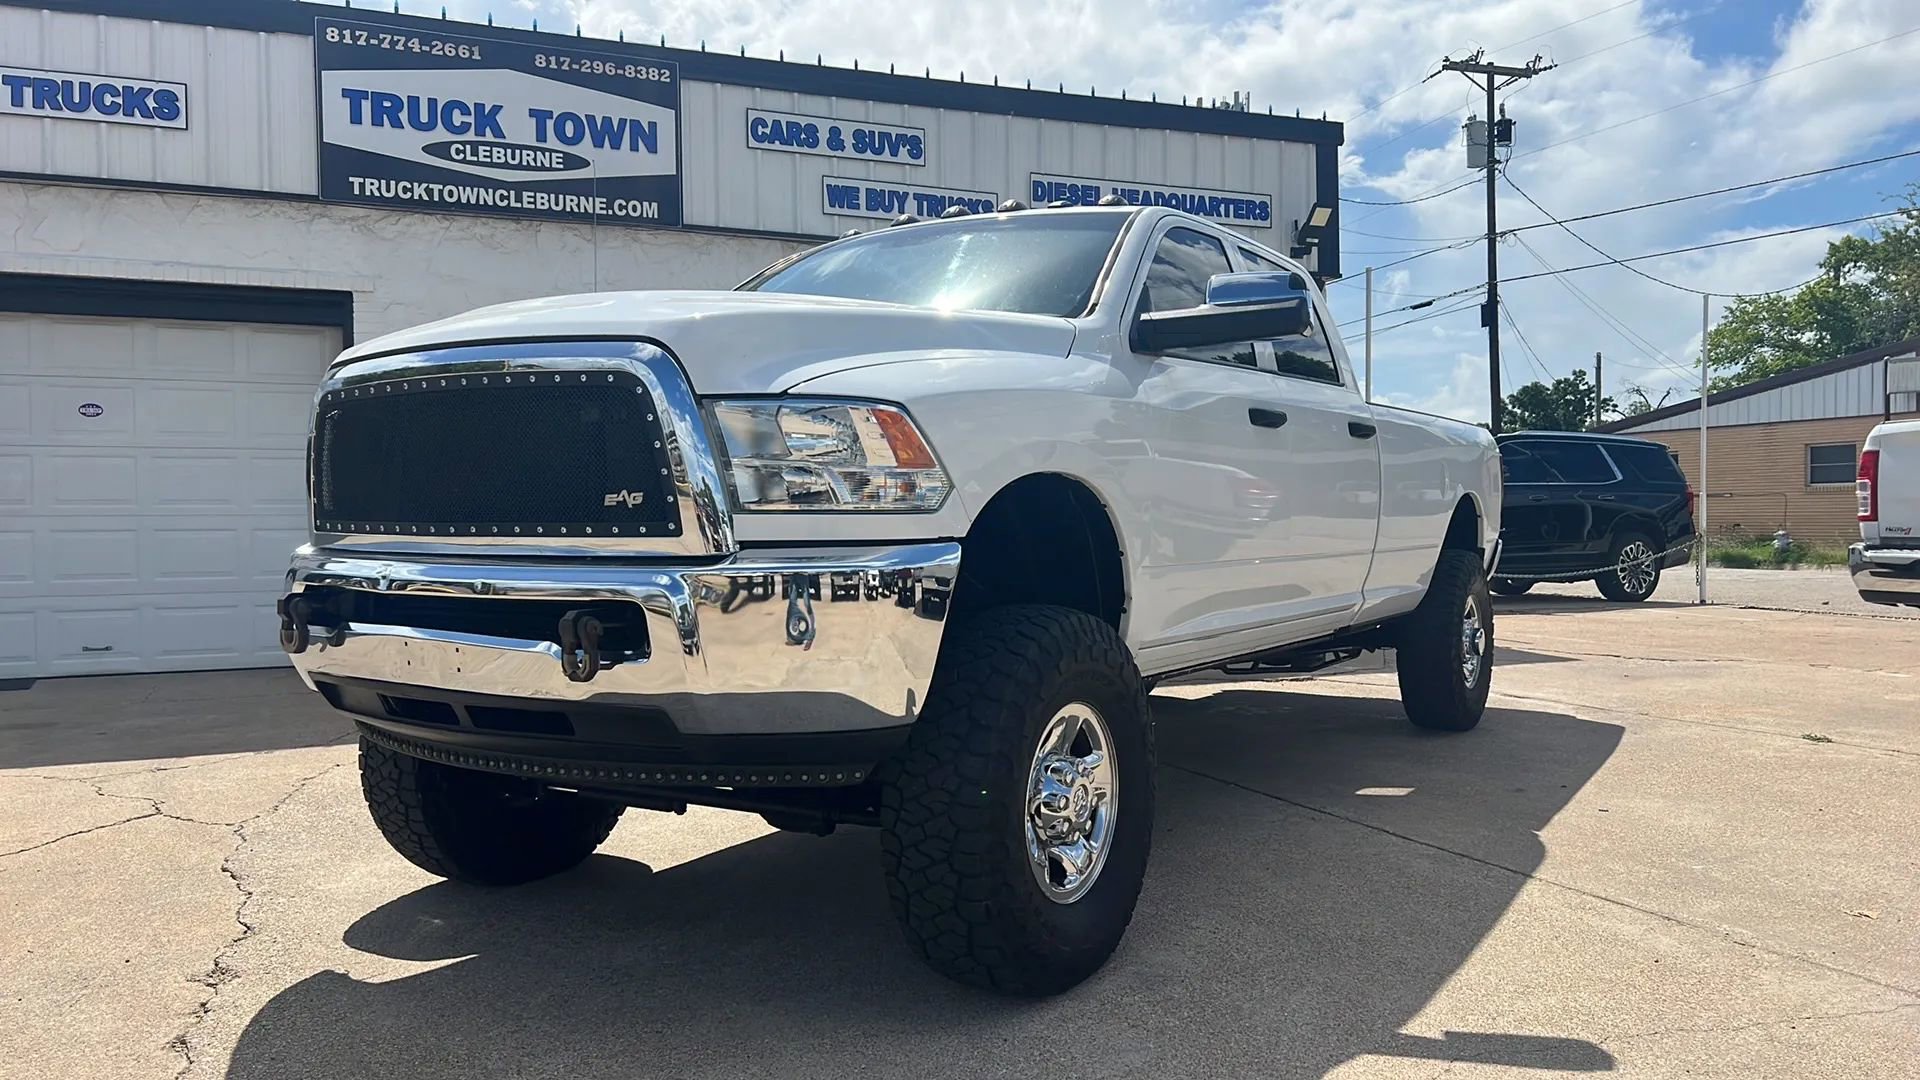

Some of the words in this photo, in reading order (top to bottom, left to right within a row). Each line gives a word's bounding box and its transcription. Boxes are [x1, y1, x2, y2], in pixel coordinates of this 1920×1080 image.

[326, 27, 482, 60] 817-774-2661
[534, 54, 671, 83] 817-296-8382
[2, 74, 180, 121] TRUCKS
[341, 88, 506, 139] TRUCK
[528, 108, 658, 154] TOWN
[750, 117, 820, 149] CARS
[826, 125, 846, 152] &
[852, 128, 923, 160] SUV'S
[450, 144, 564, 169] CLEBURNE
[349, 176, 659, 219] TRUCKTOWNCLEBURNE.COM
[826, 183, 861, 210] WE
[865, 187, 909, 214] BUY
[1032, 180, 1101, 206] DIESEL
[604, 489, 644, 509] EAG
